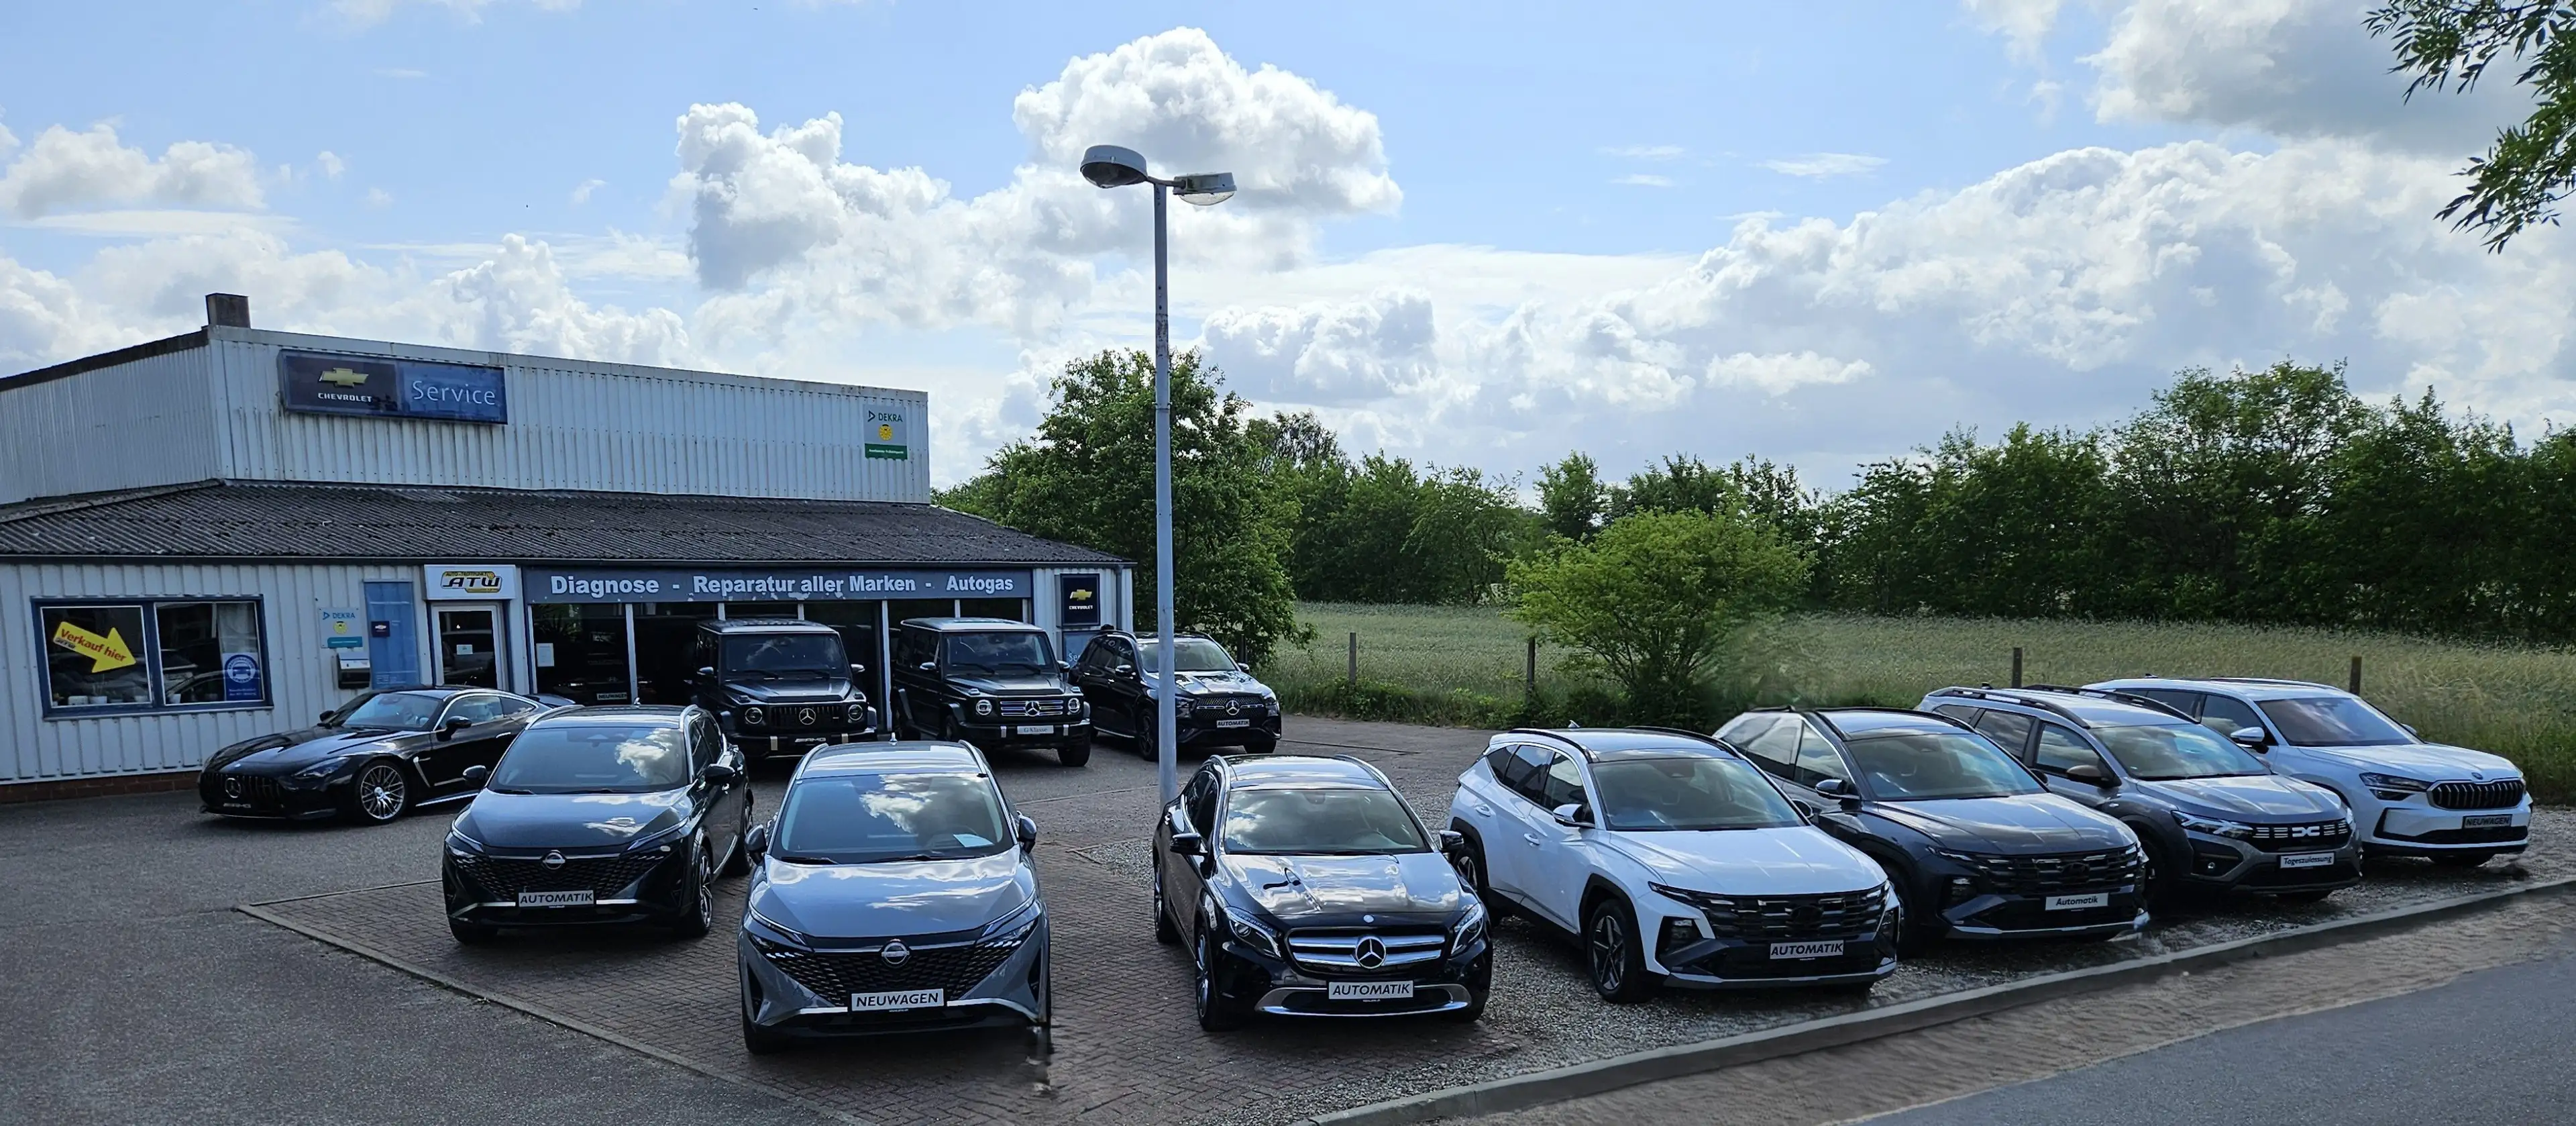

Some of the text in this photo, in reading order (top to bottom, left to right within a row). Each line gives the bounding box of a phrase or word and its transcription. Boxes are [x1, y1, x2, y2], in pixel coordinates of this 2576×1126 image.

[317, 392, 372, 403] CHEVROLET
[412, 380, 496, 405] Service
[878, 412, 903, 423] DEKRA
[442, 577, 500, 587] ATW
[550, 575, 659, 599] Diagnose
[692, 575, 796, 597] Reparatur
[800, 575, 844, 593] aller
[849, 575, 916, 592] Marken
[946, 575, 1014, 593] Autogas
[61, 628, 127, 662] Verkauf hier
[2465, 817, 2510, 826] NEUWAGEN
[2284, 856, 2332, 866] Tageszulassung
[520, 892, 593, 904] AUTOMATIK
[2055, 896, 2098, 906] Automatik
[1770, 943, 1843, 956] AUTOMATIK
[1332, 983, 1410, 996] AUTOMATIK
[856, 992, 938, 1007] NEUWAGEN
